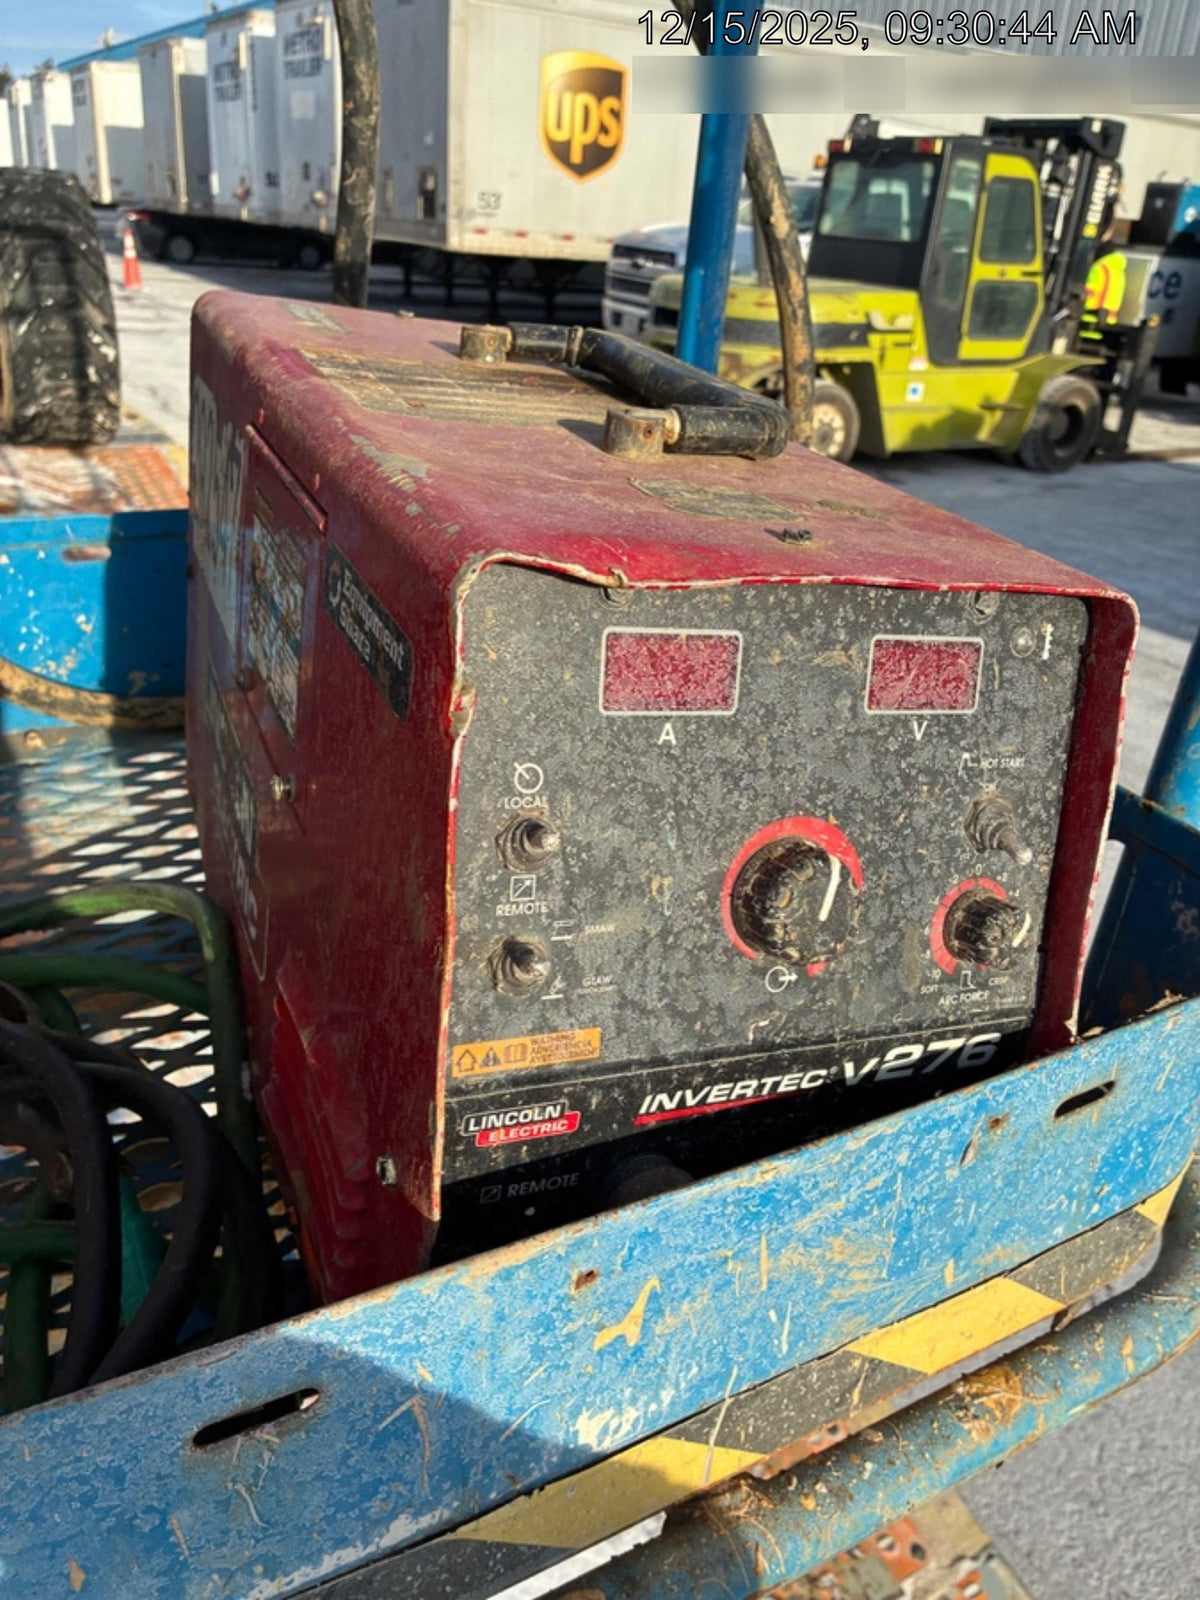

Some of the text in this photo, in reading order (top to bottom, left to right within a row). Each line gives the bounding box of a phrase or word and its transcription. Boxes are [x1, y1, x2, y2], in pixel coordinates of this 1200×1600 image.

[546, 90, 623, 164] ups
[342, 566, 405, 672] Equipment
[657, 722, 678, 746] A
[911, 720, 929, 742] V
[503, 796, 549, 810] LOCAL
[495, 902, 549, 917] REMOTE
[638, 1032, 1002, 1115] INVERTEC V276
[467, 1104, 563, 1132] LINCOLN
[487, 1119, 570, 1143] ELECTRIC
[507, 1173, 580, 1198] REMOTE
